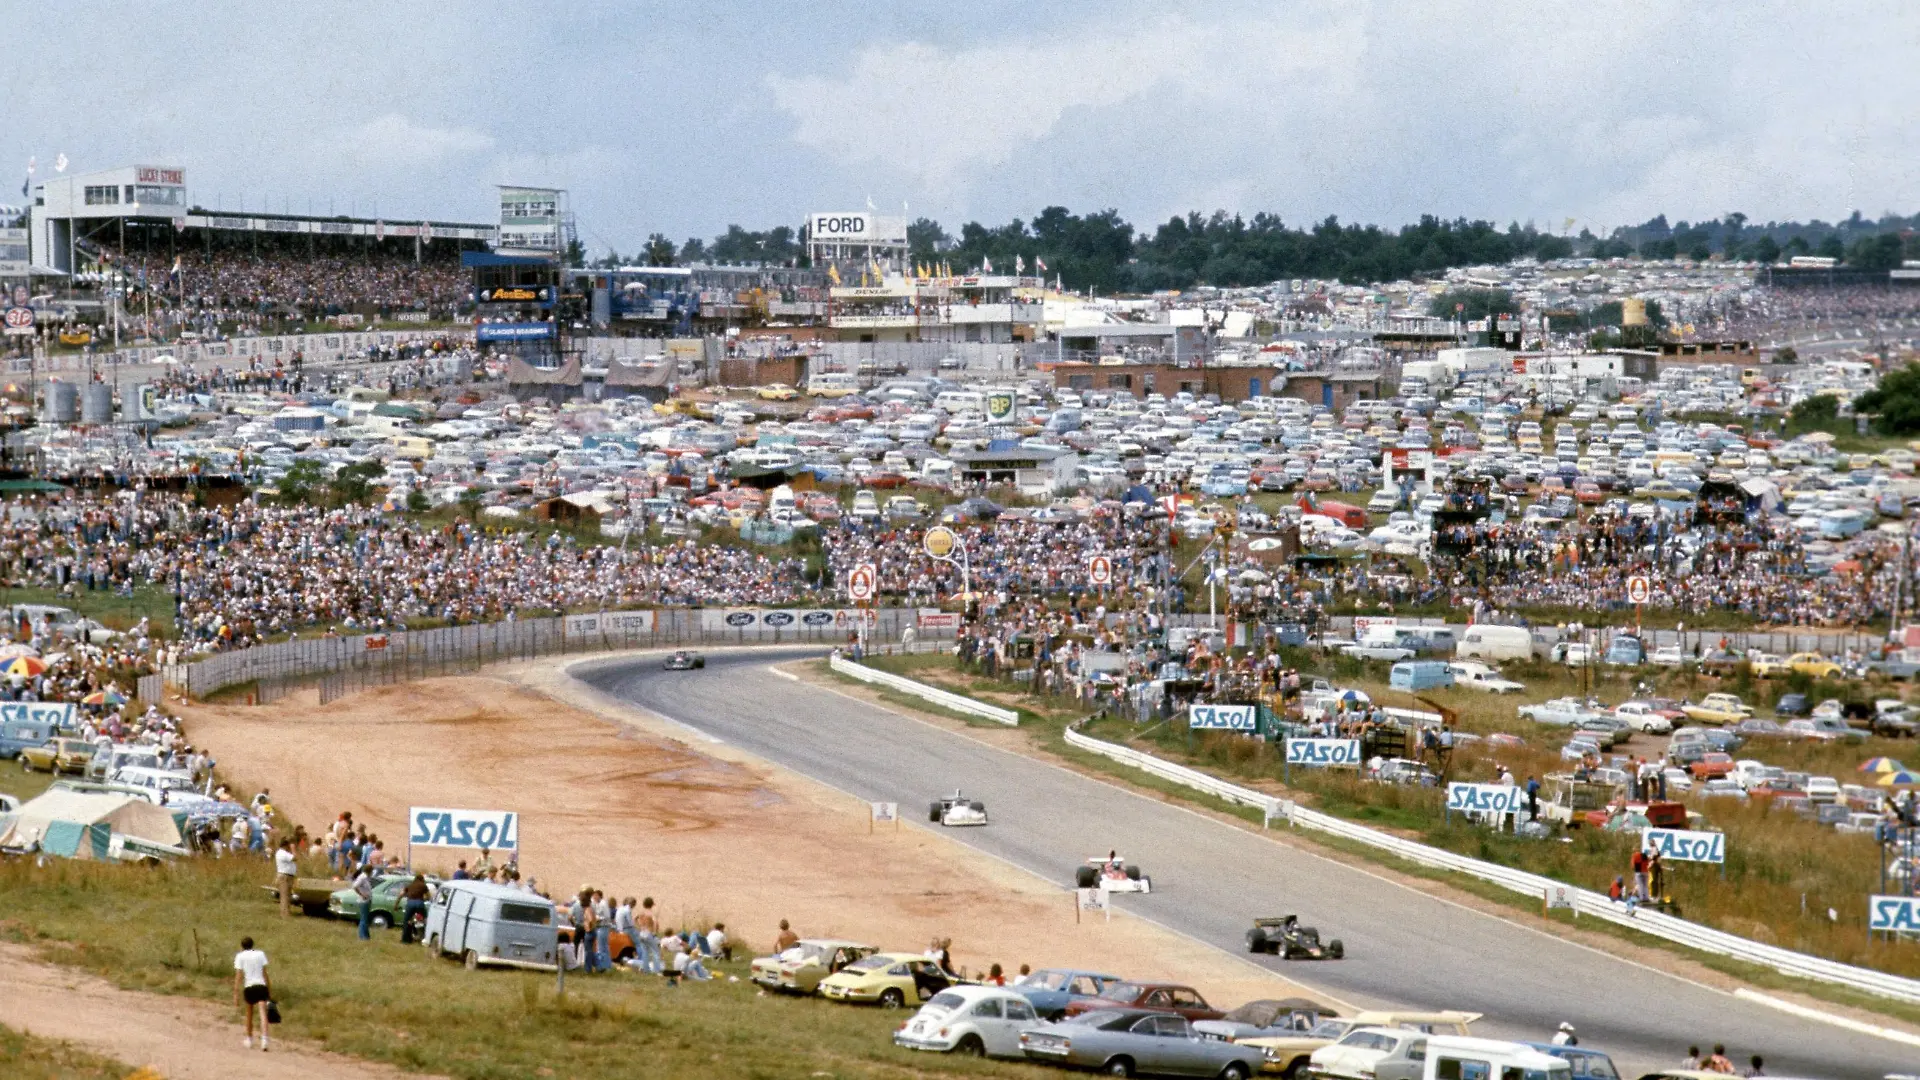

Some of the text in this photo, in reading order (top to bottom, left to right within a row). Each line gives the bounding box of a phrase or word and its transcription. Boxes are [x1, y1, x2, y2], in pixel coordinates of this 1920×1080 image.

[139, 168, 158, 182] LUCKY
[817, 217, 864, 233] FORD
[8, 311, 32, 325] STP
[990, 397, 1010, 413] BP
[622, 616, 643, 628] CITIZEN
[1191, 708, 1255, 728] SASOL
[1288, 741, 1359, 763] SASOL
[1449, 786, 1521, 811] SASOL
[411, 812, 516, 848] SASOL
